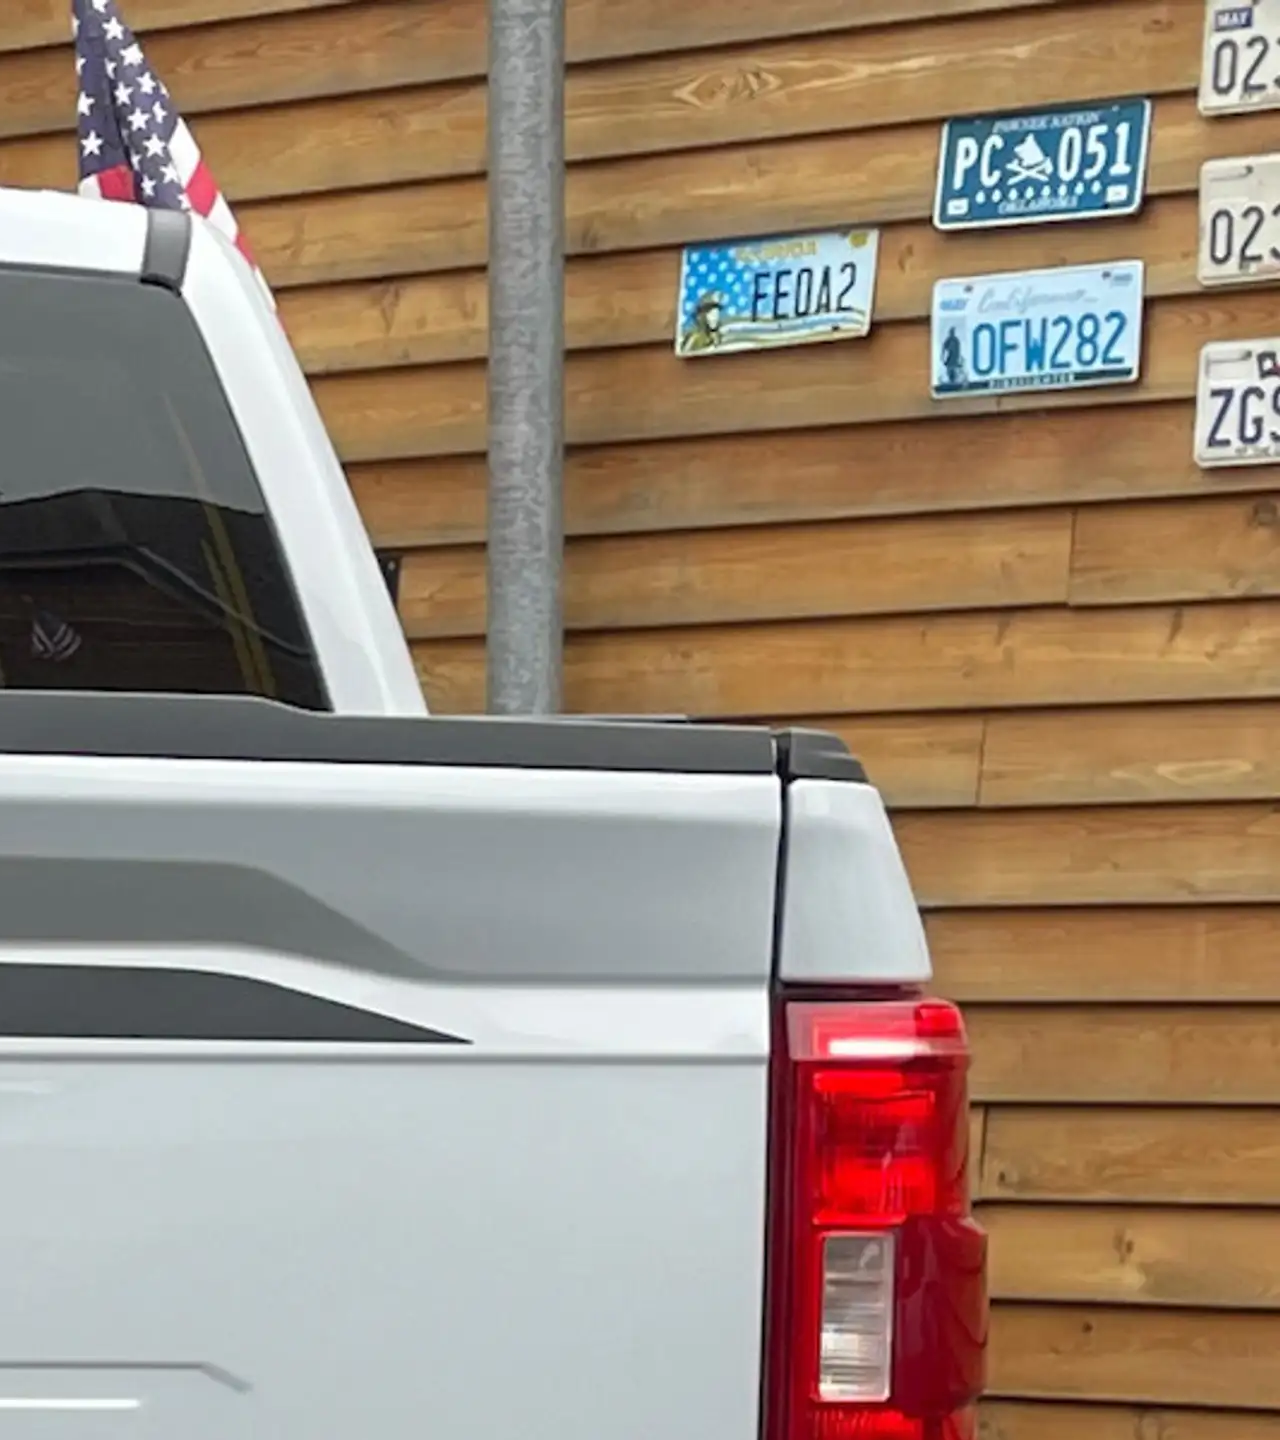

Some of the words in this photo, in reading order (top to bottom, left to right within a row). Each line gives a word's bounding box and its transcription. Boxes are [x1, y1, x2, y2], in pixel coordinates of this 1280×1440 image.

[1217, 11, 1249, 28] MAY
[1212, 35, 1280, 95] 02
[953, 132, 1004, 191] PC
[1056, 122, 1131, 182] 051
[1210, 204, 1280, 269] 02
